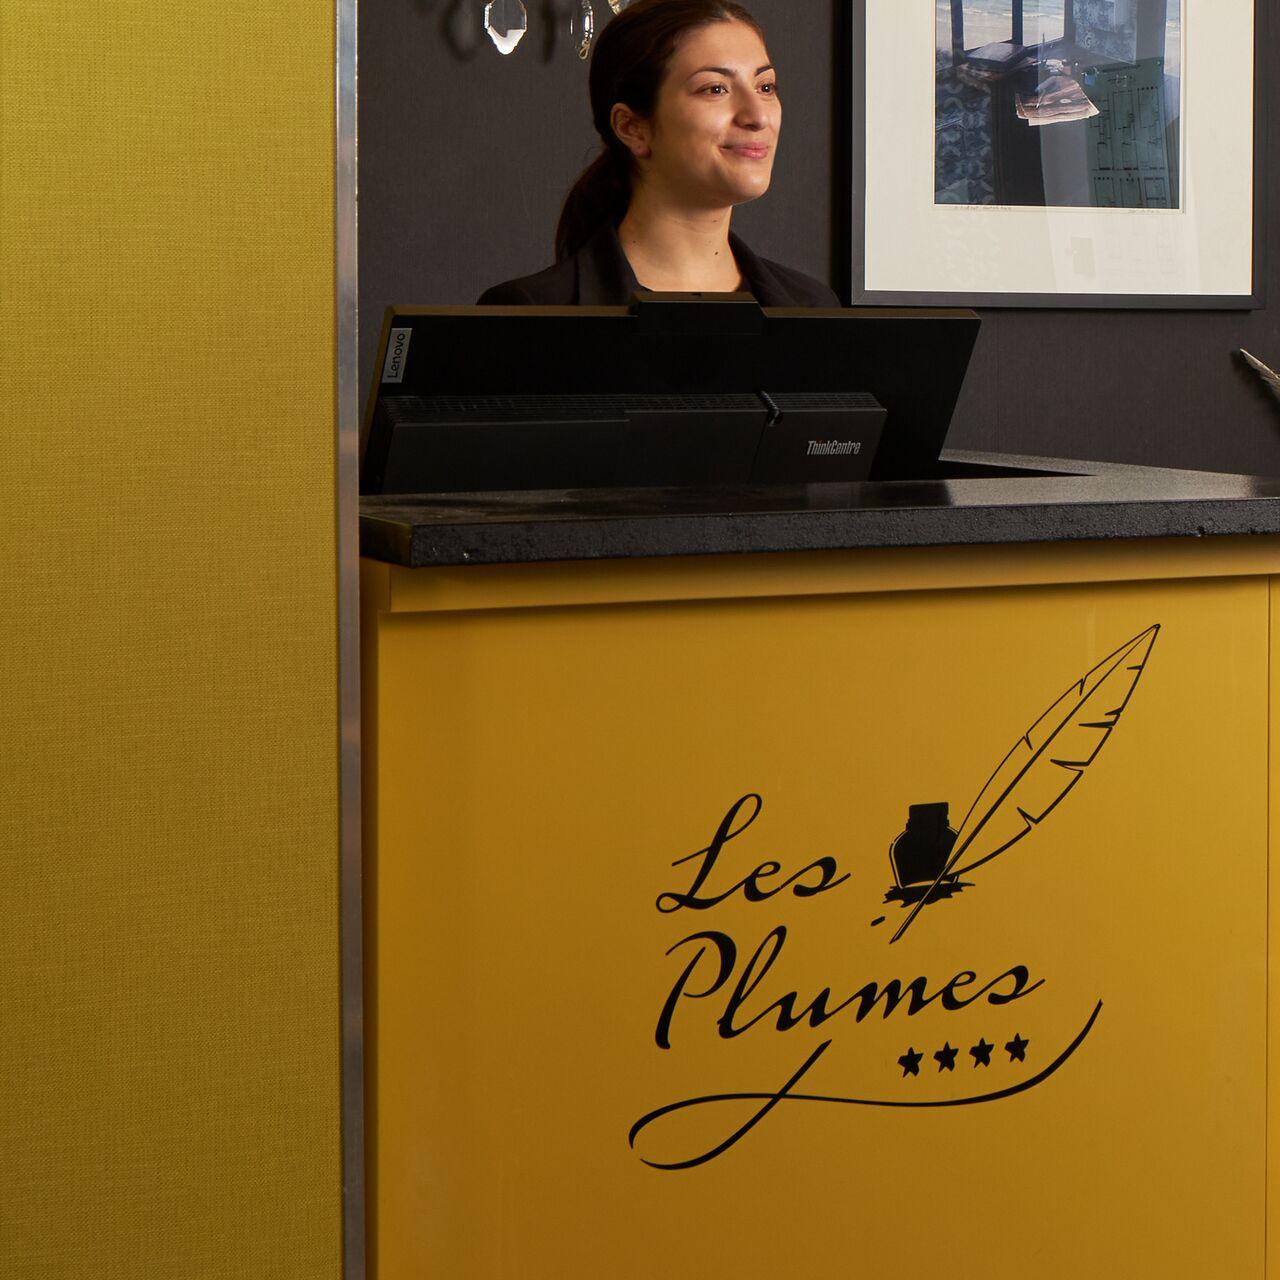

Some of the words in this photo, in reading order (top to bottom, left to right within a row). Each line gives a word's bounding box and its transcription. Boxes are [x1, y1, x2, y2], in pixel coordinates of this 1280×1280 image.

[387, 333, 406, 378] Lenovo
[806, 439, 861, 456] ThinkCentre
[655, 793, 851, 914] Les
[655, 925, 1047, 1050] Plumes
